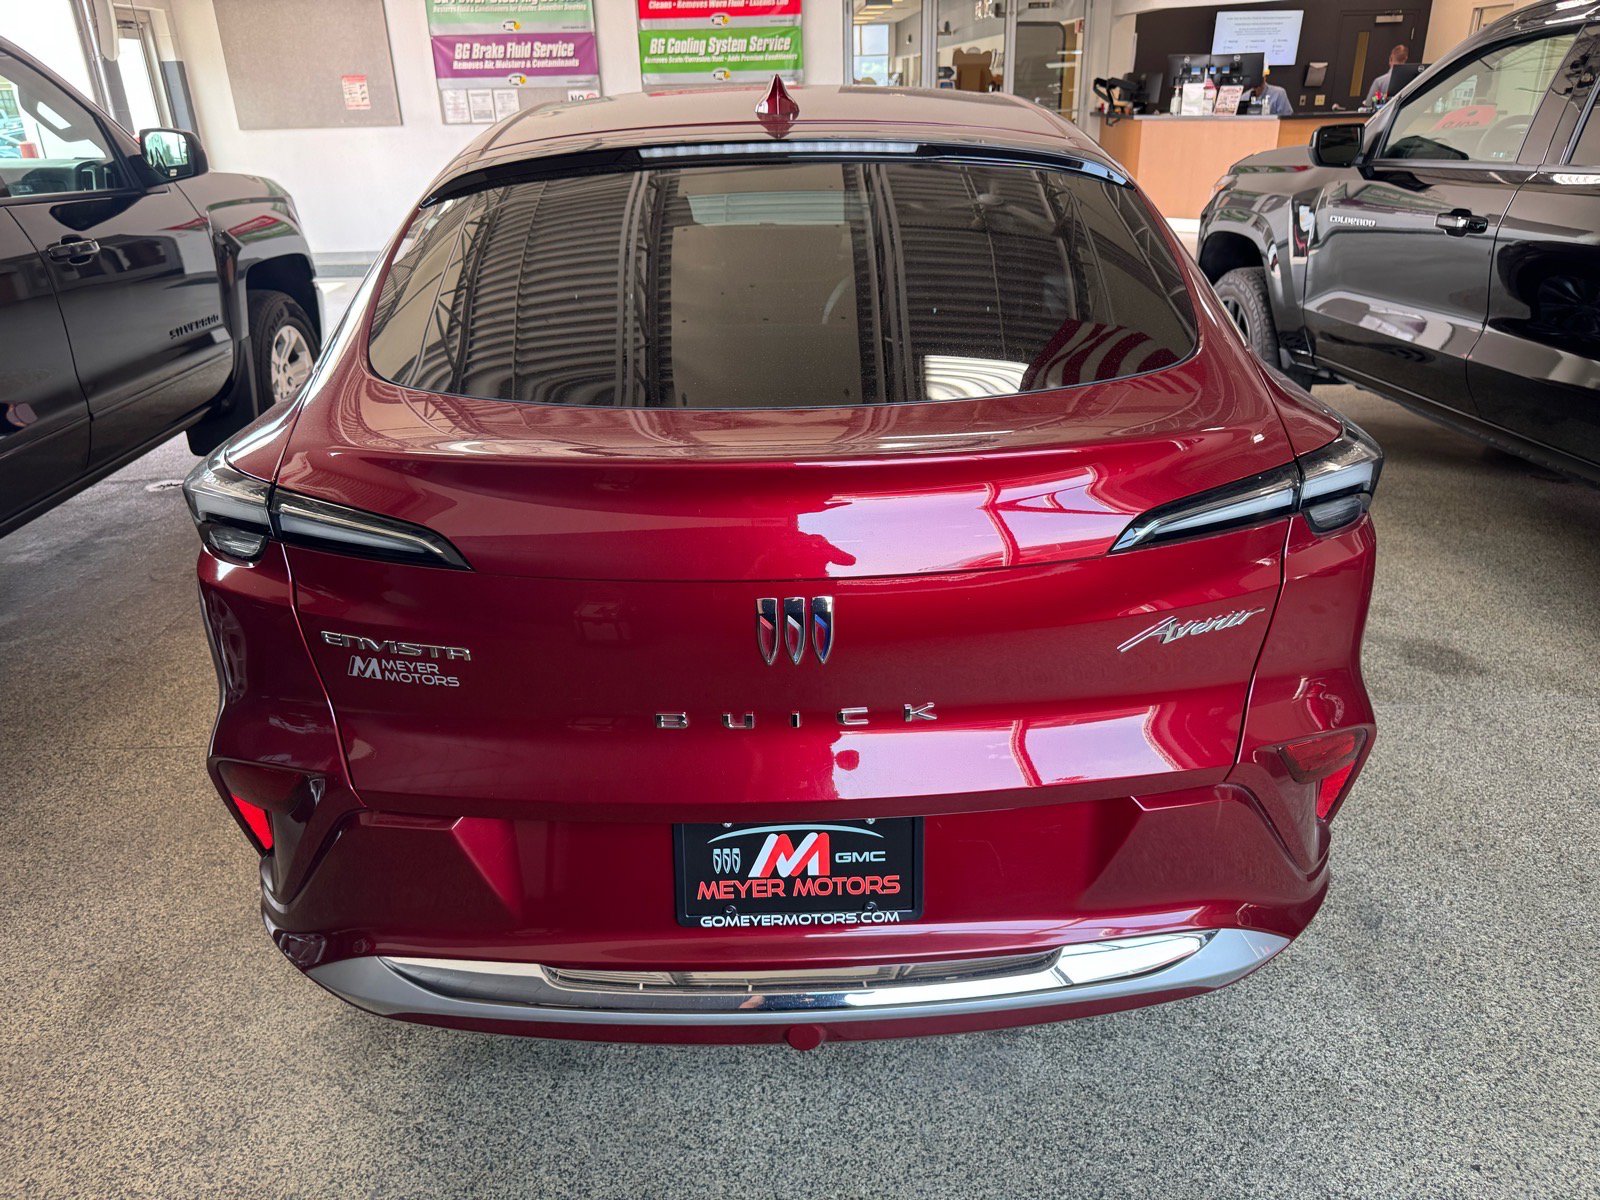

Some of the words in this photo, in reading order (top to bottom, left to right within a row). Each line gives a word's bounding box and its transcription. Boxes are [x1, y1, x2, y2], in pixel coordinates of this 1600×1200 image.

[648, 0, 672, 9] Cleans
[677, 0, 708, 9] Removes
[709, 0, 727, 8] Worn
[454, 42, 471, 60] BG
[471, 42, 504, 60] Brake
[506, 41, 532, 59] Fluid
[533, 40, 575, 58] Service
[650, 38, 666, 55] BG
[667, 37, 706, 56] Cooling
[708, 36, 747, 56] System
[749, 35, 791, 52] Service
[453, 60, 483, 70] Removes
[495, 59, 525, 69] Moisture
[532, 58, 580, 69] Contaminants
[1329, 214, 1376, 228] COLORADO
[1117, 608, 1266, 653] Avenir
[320, 630, 471, 661] ENVISTA
[381, 658, 440, 675] MEYER
[384, 672, 460, 687] MOTORS
[656, 702, 937, 729] BUICK
[835, 850, 886, 863] GMC
[697, 878, 786, 900] MEYER
[793, 875, 901, 897] MOTORS
[700, 911, 900, 928] GOMEYERMOTORS.COM
